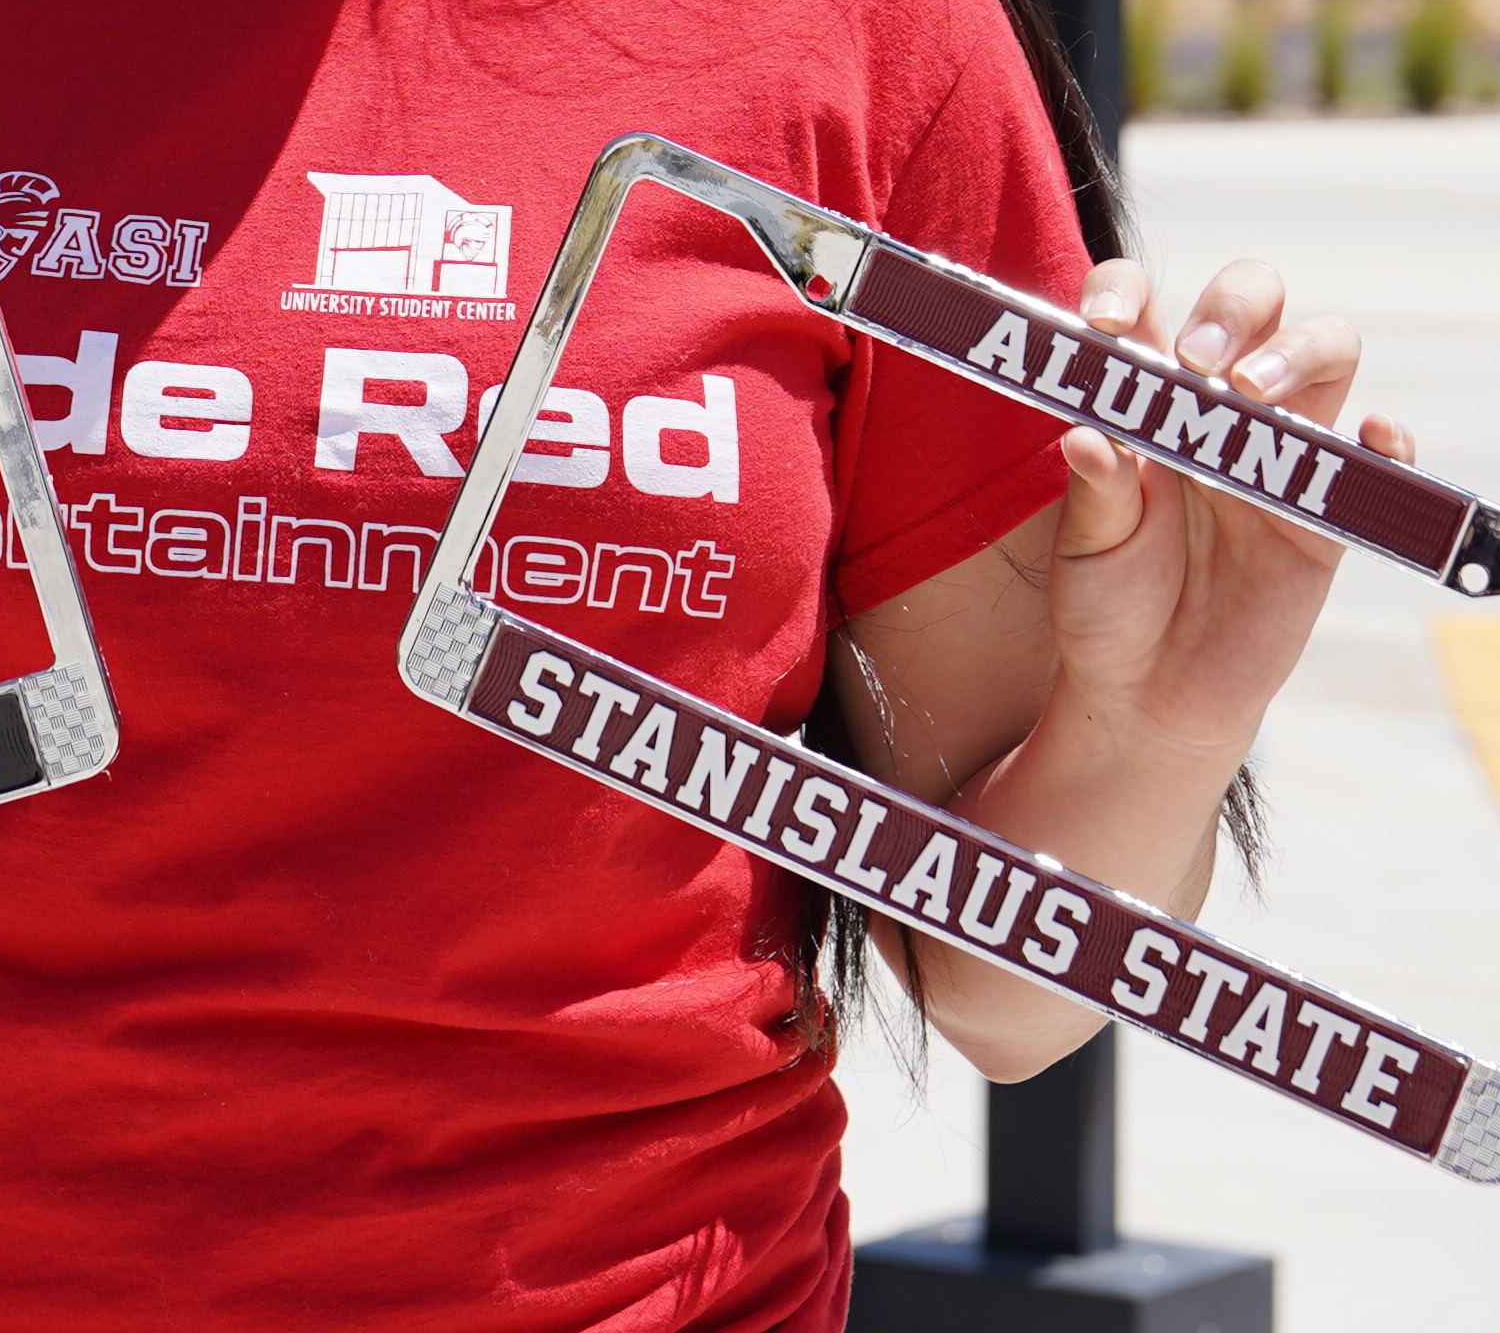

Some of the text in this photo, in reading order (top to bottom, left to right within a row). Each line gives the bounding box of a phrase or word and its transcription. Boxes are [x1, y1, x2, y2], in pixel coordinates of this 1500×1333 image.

[31, 208, 209, 287] ASI
[281, 290, 516, 320] UNIVERSITY STUDENT CENTER
[314, 347, 740, 504] Red
[966, 310, 1345, 516] ALUMNI
[507, 651, 1419, 1129] STANISLAUS STATE
